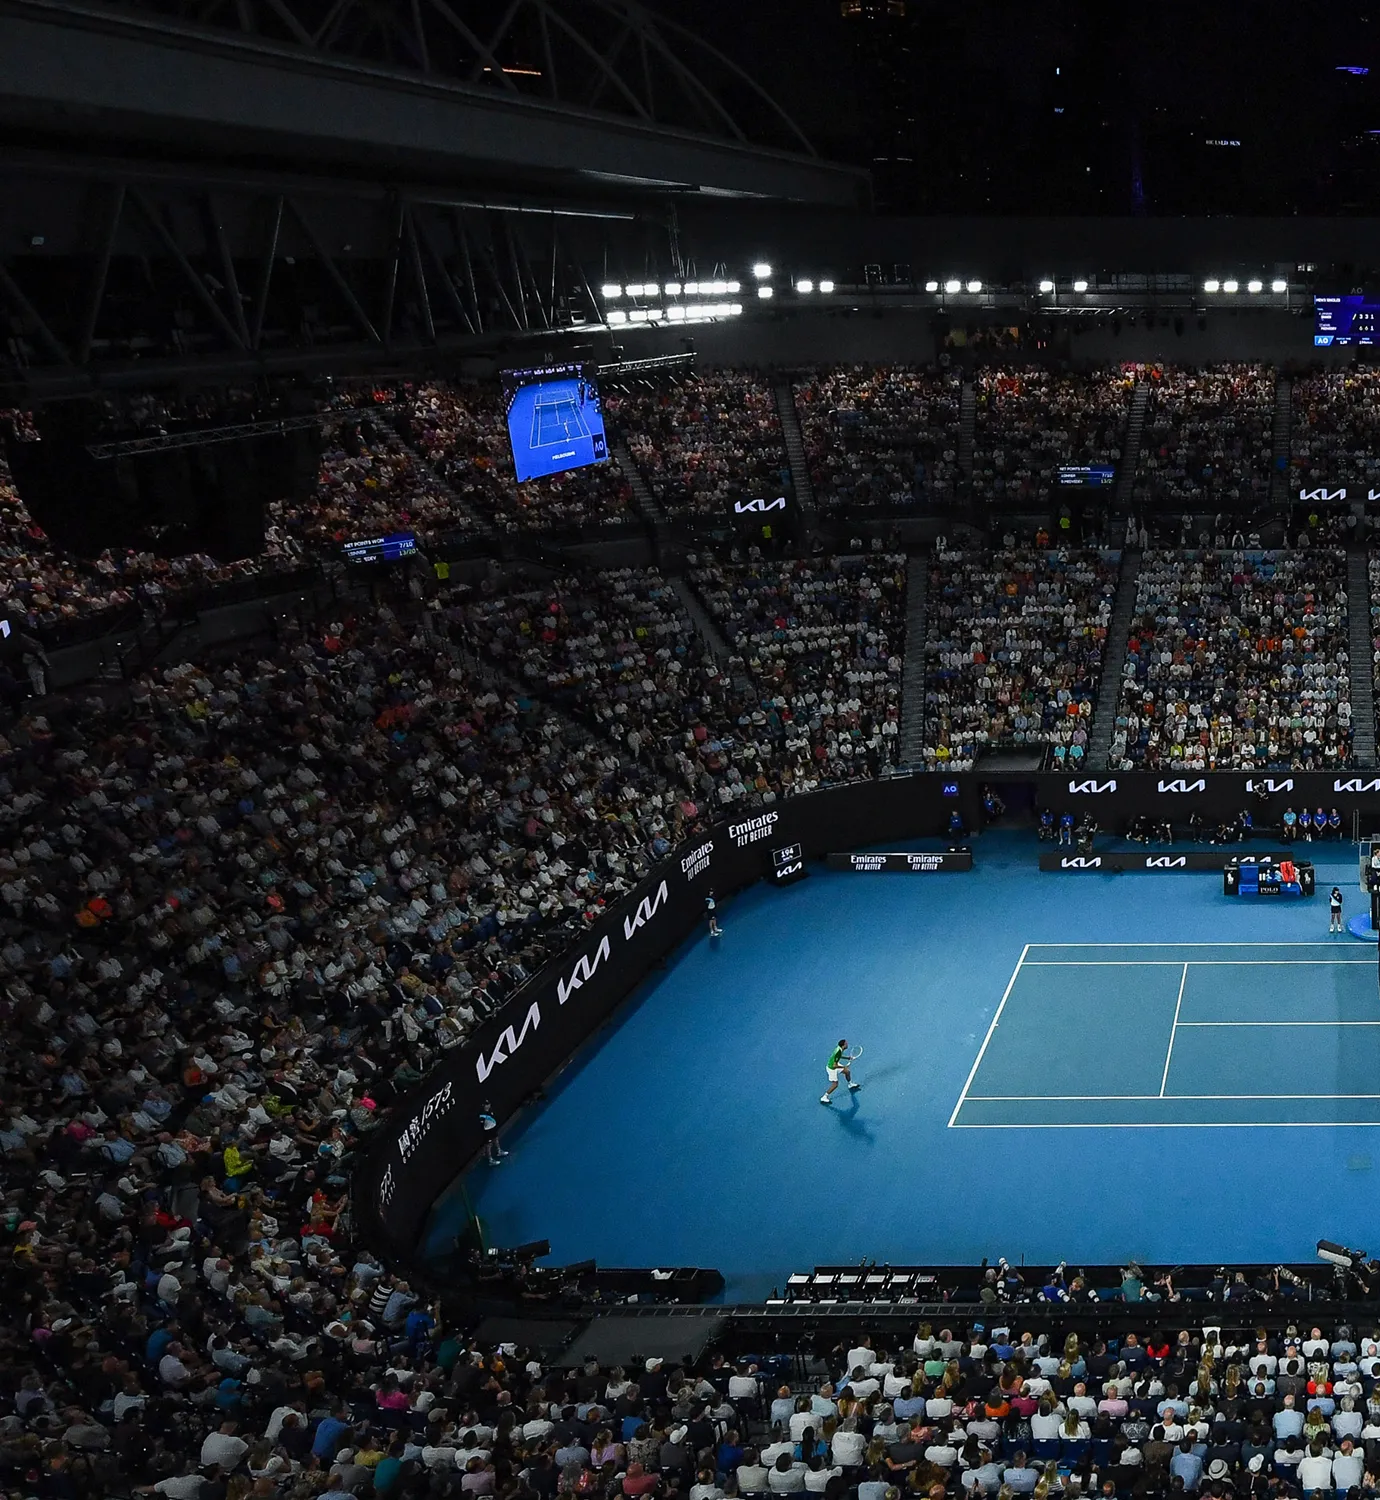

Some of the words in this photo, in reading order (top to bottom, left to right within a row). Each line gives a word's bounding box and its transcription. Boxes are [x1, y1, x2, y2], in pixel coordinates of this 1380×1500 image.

[1300, 489, 1346, 500] KIA
[735, 498, 785, 513] KIA
[1069, 780, 1117, 793] KIA
[1158, 779, 1206, 792] KIA
[1334, 779, 1380, 791] KIA
[728, 811, 778, 838] Emirates
[737, 834, 748, 847] FLY
[750, 825, 772, 842] BETTER
[681, 841, 714, 872] Emirates
[851, 855, 887, 863] Emirates
[907, 855, 943, 863] Emirates
[1061, 857, 1101, 868] KIA
[1146, 856, 1186, 867] KIA
[777, 862, 802, 877] KIA
[624, 880, 668, 940] KIA
[557, 935, 610, 1005] KIA
[476, 1002, 541, 1083] KIA
